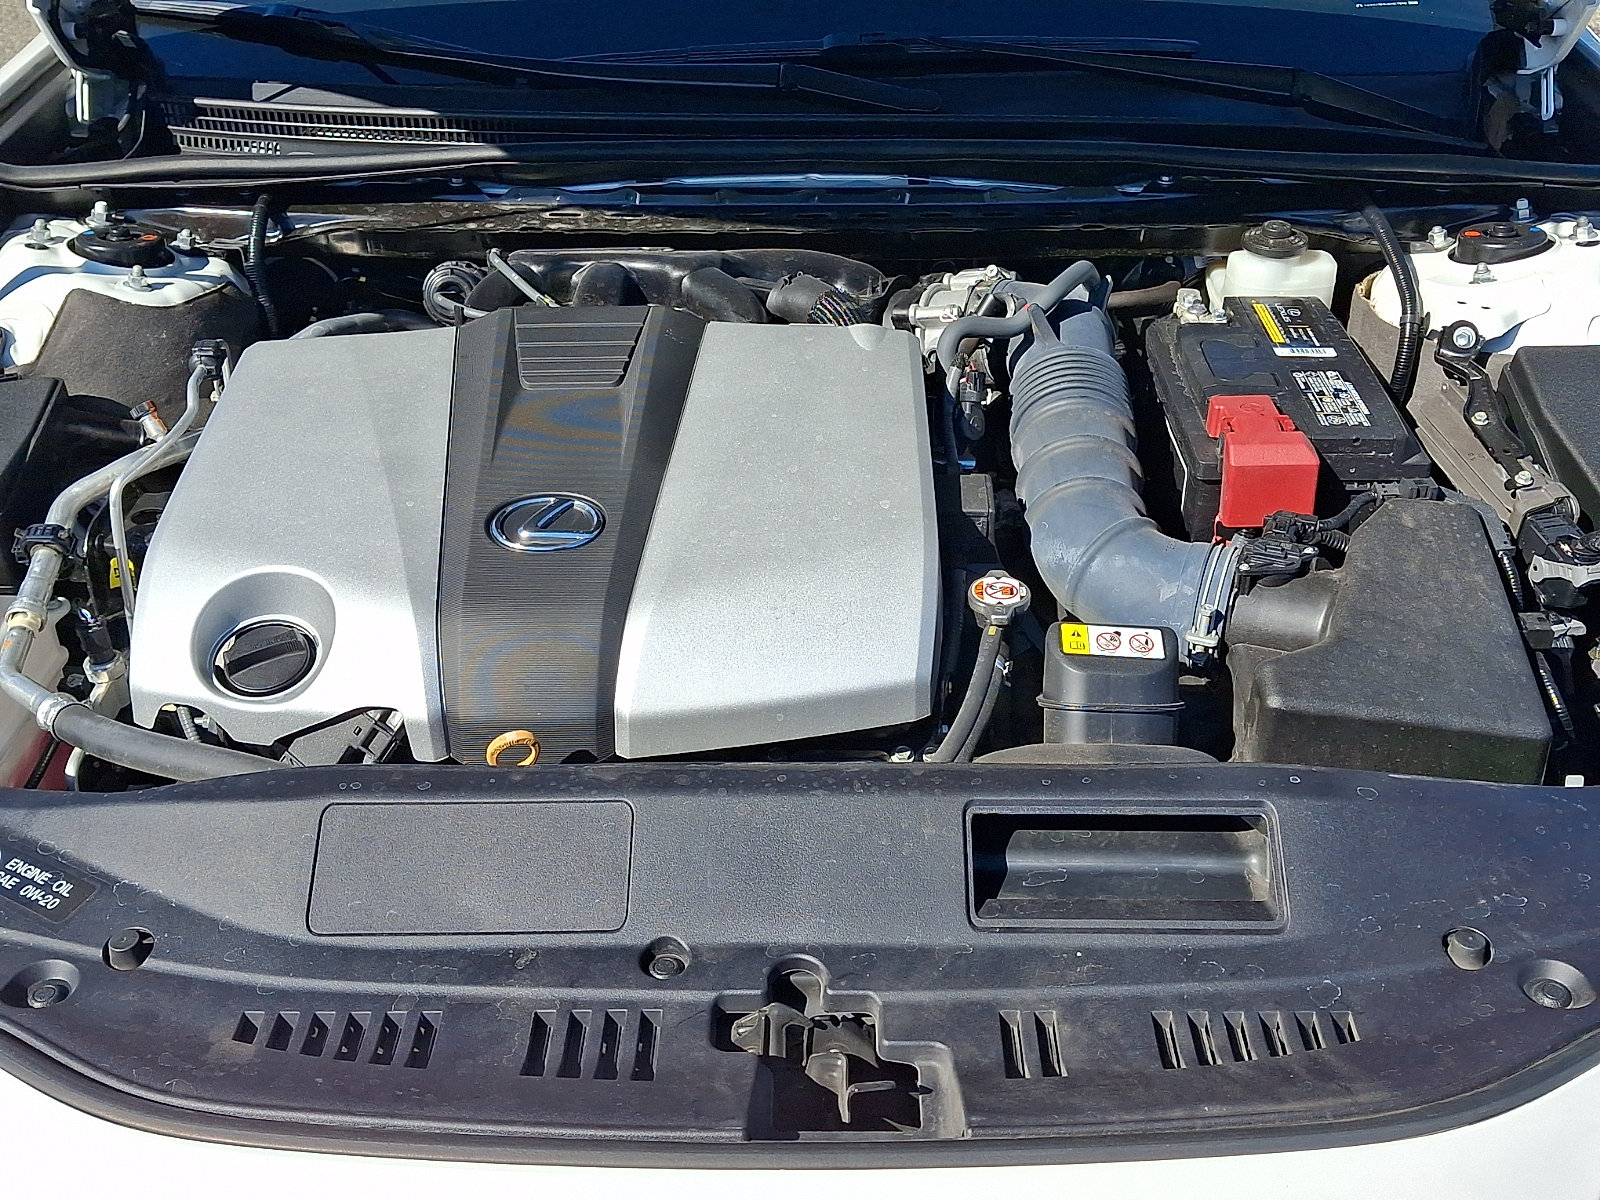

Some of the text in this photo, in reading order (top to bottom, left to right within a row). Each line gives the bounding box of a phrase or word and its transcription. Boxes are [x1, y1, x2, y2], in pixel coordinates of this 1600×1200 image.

[1274, 302, 1292, 323] LEXUS
[4, 857, 74, 898] ENGINE OIL
[19, 884, 61, 910] 0W-20
